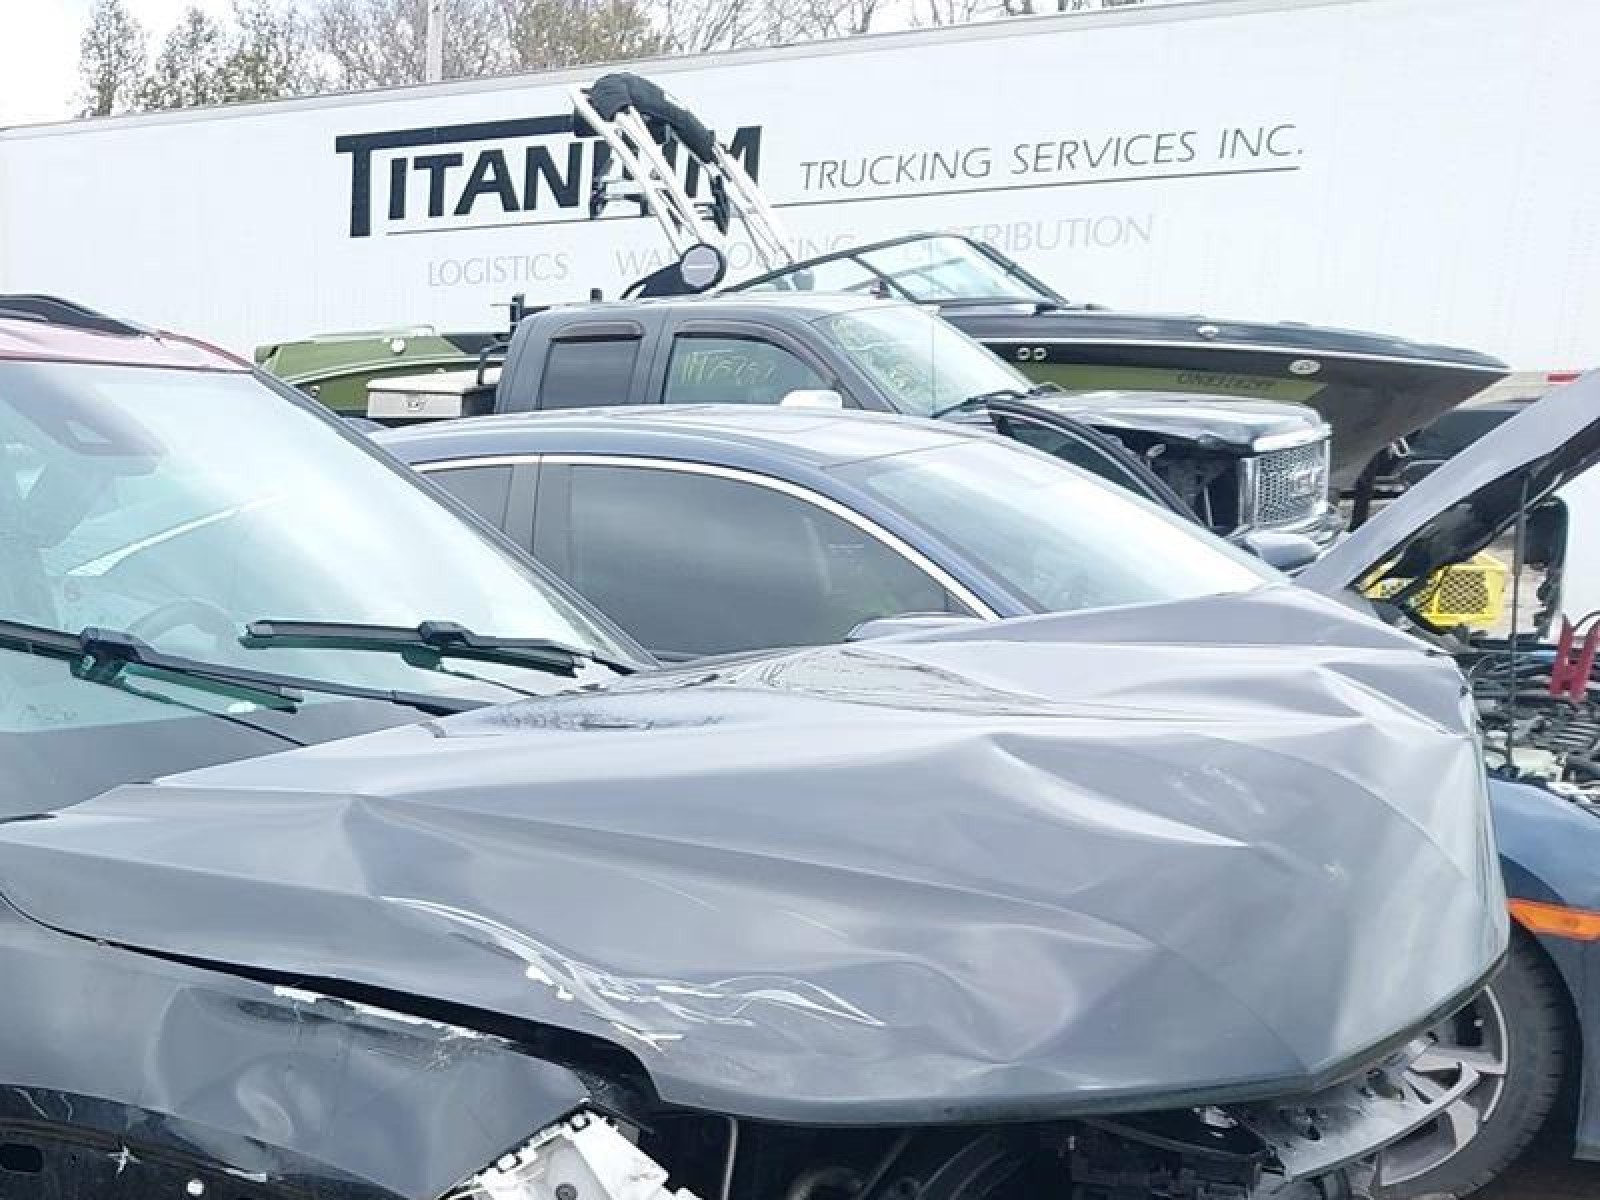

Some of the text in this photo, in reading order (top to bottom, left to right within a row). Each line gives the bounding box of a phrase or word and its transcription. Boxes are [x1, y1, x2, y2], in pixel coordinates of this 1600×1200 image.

[800, 146, 992, 191] TRUCKING
[1011, 129, 1198, 176] SERVICES
[1218, 122, 1305, 159] INC.
[428, 251, 569, 287] LOGISTICS
